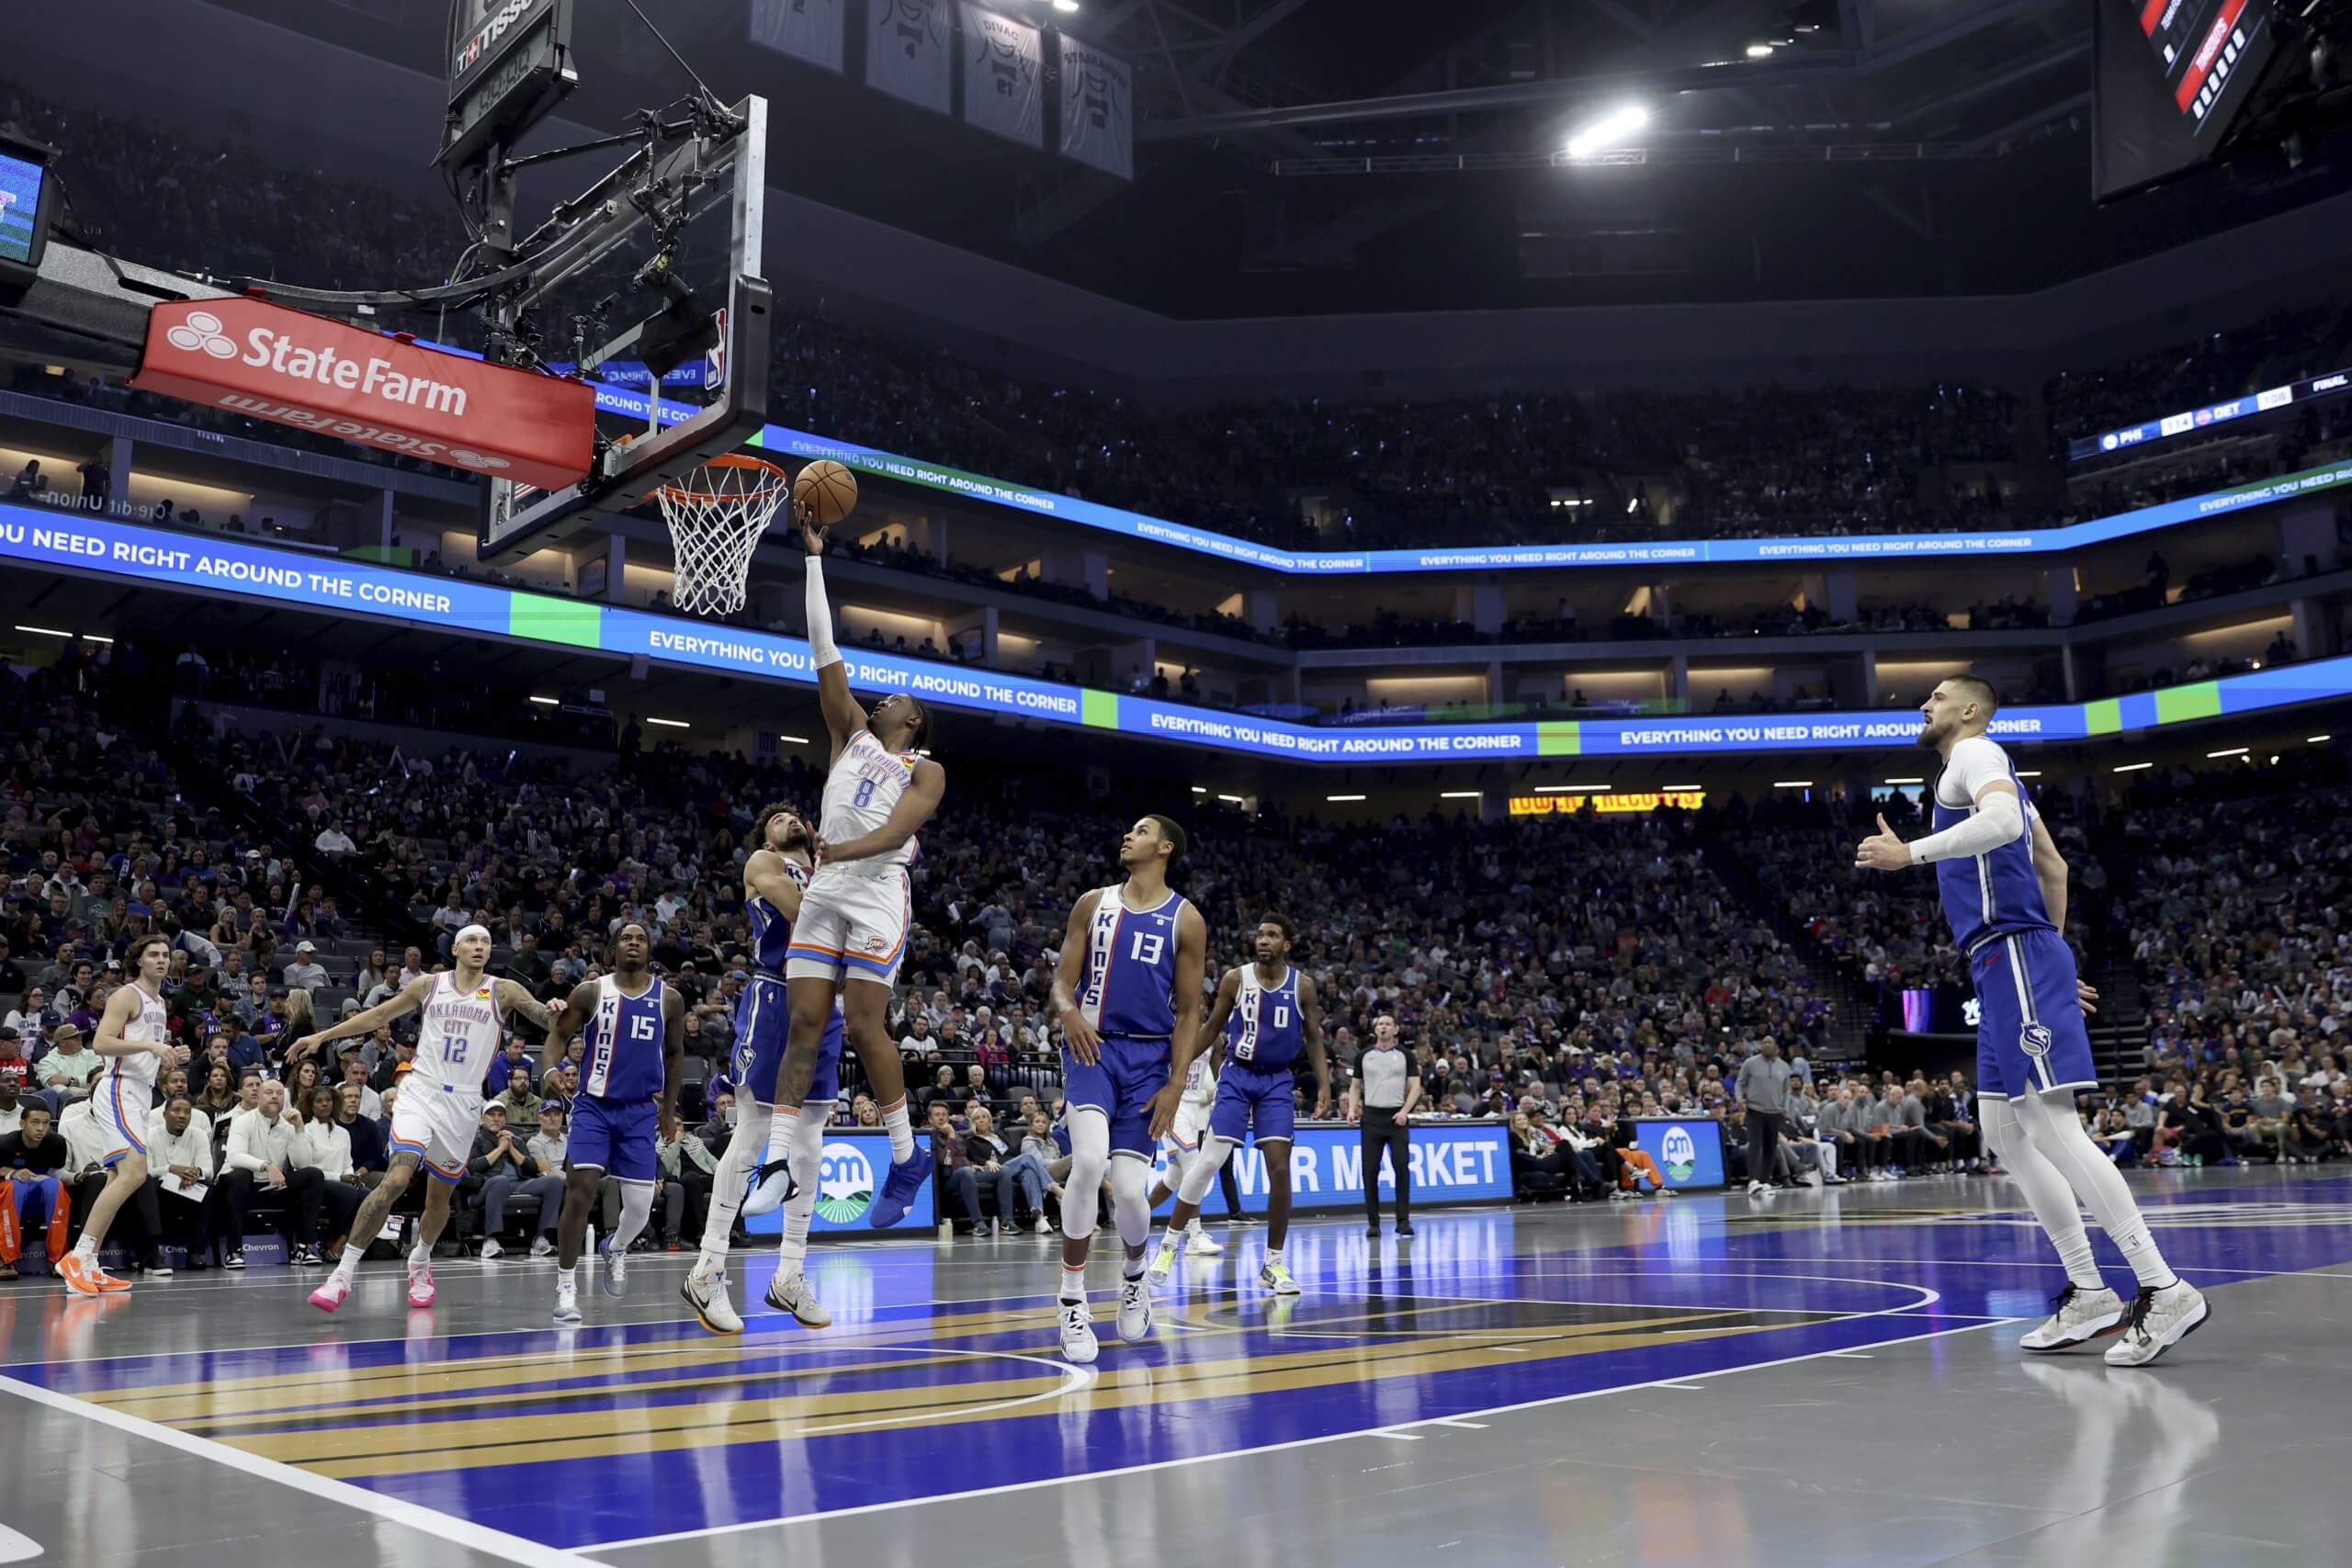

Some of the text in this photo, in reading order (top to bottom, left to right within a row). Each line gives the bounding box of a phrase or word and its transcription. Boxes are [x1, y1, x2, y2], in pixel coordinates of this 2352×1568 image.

[983, 20, 1019, 40] DIVAC
[597, 392, 642, 412] ROUND
[2120, 429, 2143, 445] PHI
[2214, 402, 2242, 420] DET
[2312, 375, 2348, 392] FINAL
[792, 441, 1055, 511] EVERYTHING YOU NEED RIGHT AROUND THE CORNER
[2199, 487, 2272, 512] EVERYTHING
[2273, 480, 2299, 495] YOU
[2301, 473, 2335, 489] NEED
[1137, 522, 1363, 569] EVERYTHING YOU NEED RIGHT AROUND THE CORNER
[1420, 547, 1695, 567] EVERYTHING YOU NEED RIGHT AROUND THE CORNER
[1759, 537, 2032, 556] EVERYTHING YOU NEED RIGHT AROUND THE CORNER
[33, 528, 106, 556] NEED
[113, 542, 190, 570] RIGHT
[195, 556, 302, 588] AROUND
[309, 574, 353, 597] THE
[358, 582, 451, 614] CORNER
[650, 630, 763, 663] EVERYTHING
[768, 649, 805, 670] YOU
[860, 666, 909, 687] RIGHT
[911, 673, 981, 698] AROUND
[983, 685, 1013, 704] THE
[1016, 691, 1077, 715] CORNER
[1151, 713, 1521, 753] EVERYTHING YOU NEED RIGHT AROUND THE CORNER
[1621, 719, 2041, 745] EVERYTHING YOU NEED RIGHT AROUN ORNER
[852, 777, 876, 808] 8
[1085, 913, 1114, 1007] KINGS
[1131, 931, 1164, 964] 13
[430, 1003, 492, 1025] OKLAHOMA
[444, 1019, 471, 1036] CITY
[630, 1014, 656, 1041] 15
[1238, 993, 1256, 1058] KINGS
[1273, 1006, 1289, 1028] 0
[443, 1036, 468, 1063] 12
[595, 1001, 616, 1076] KINGS
[1667, 1136, 1690, 1162] pm
[1147, 1141, 1498, 1196] PWR MARKET
[243, 1242, 279, 1252] Chevron
